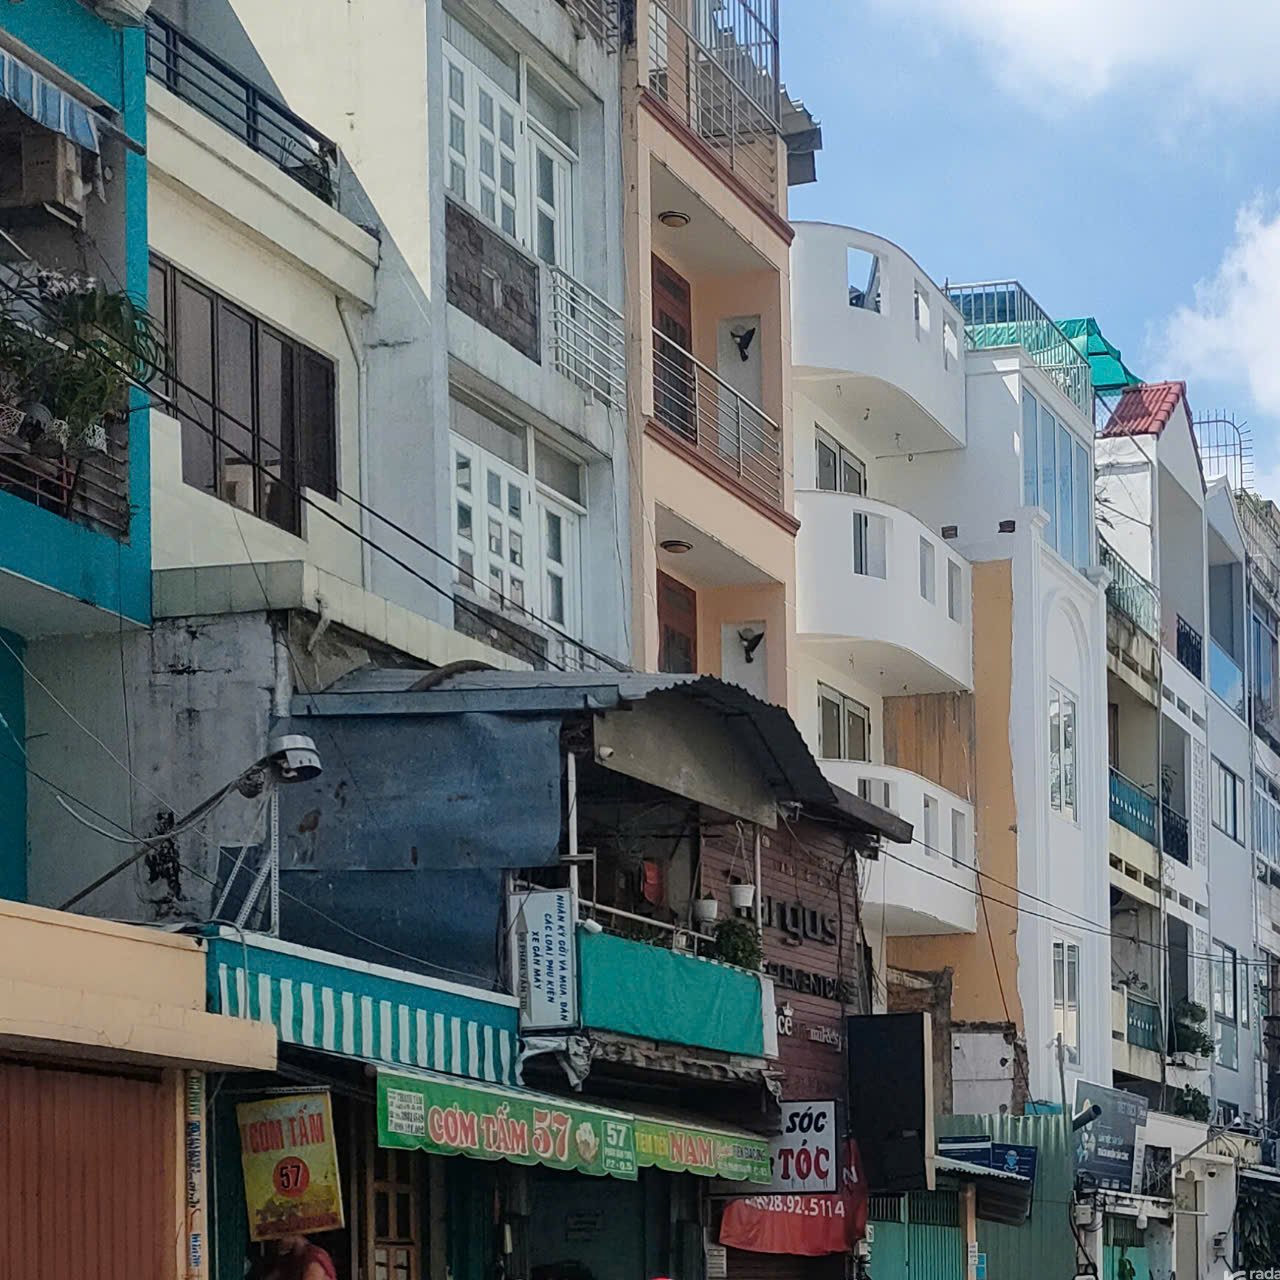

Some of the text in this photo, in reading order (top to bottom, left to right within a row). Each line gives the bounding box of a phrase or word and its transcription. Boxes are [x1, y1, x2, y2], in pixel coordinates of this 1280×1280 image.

[428, 1102, 479, 1150] CƠM
[481, 1101, 529, 1156] TẤM
[533, 1107, 572, 1163] 57
[606, 1122, 627, 1148] 57
[785, 1105, 828, 1134] SÓC
[668, 1130, 716, 1169] NAM
[777, 1138, 831, 1181] TÓC
[278, 1164, 302, 1190] 57
